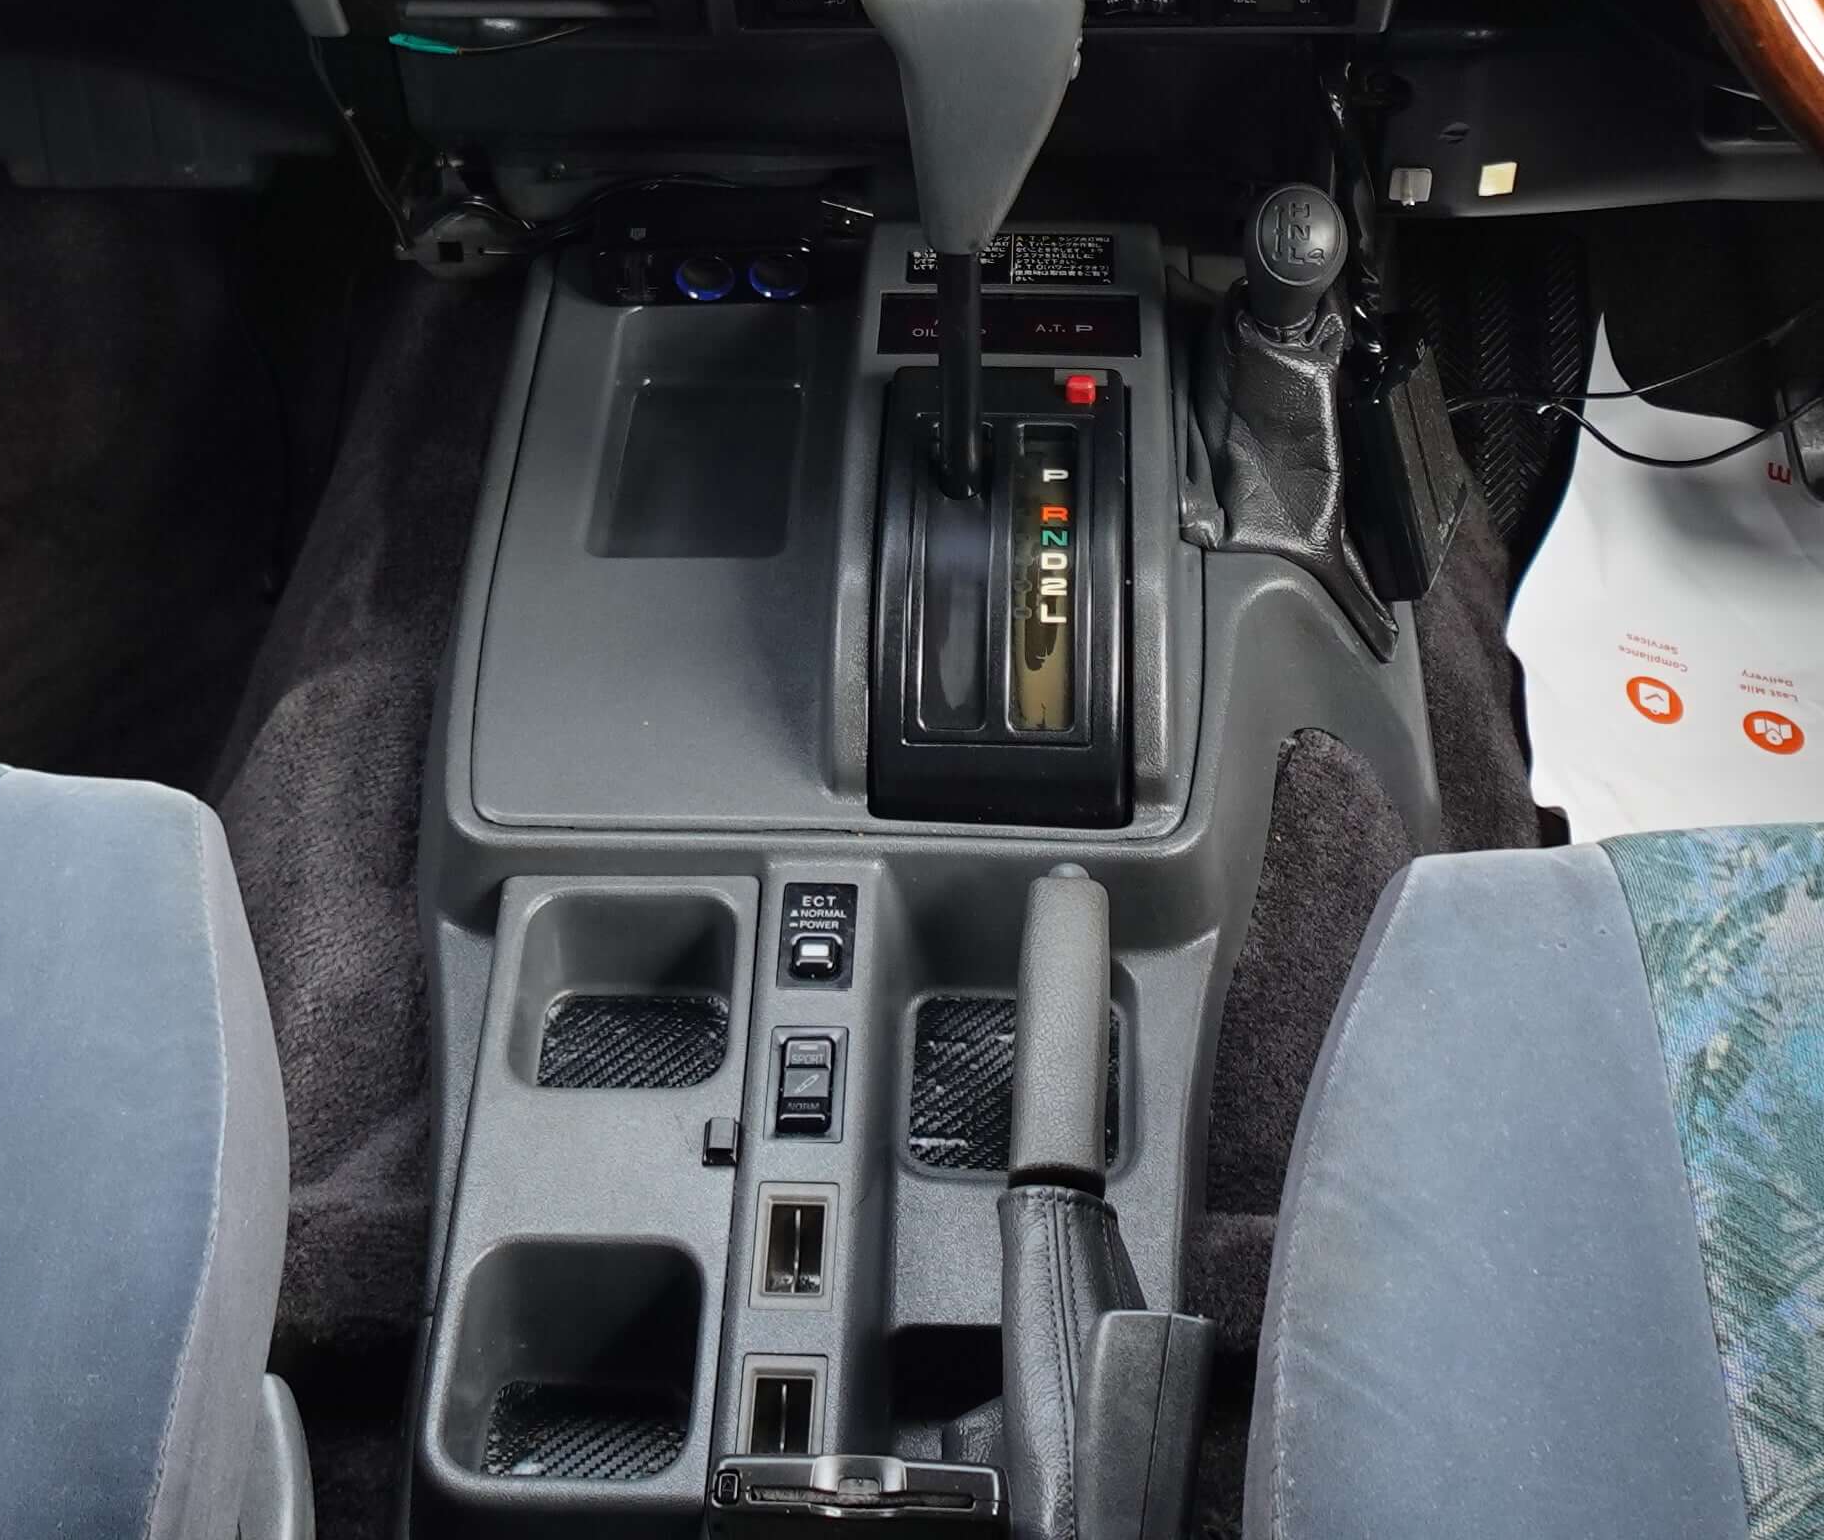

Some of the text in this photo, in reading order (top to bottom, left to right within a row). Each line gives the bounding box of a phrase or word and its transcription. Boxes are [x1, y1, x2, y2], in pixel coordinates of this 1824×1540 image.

[1039, 468, 1070, 624] P R N D 2 L
[1626, 632, 1680, 655] Services
[1618, 644, 1689, 673] Compliance
[1741, 668, 1794, 688] Delivery
[1739, 683, 1799, 703] Last Mile
[801, 895, 838, 907] ECT
[800, 909, 847, 919] NORMAL
[799, 920, 840, 930] POWER
